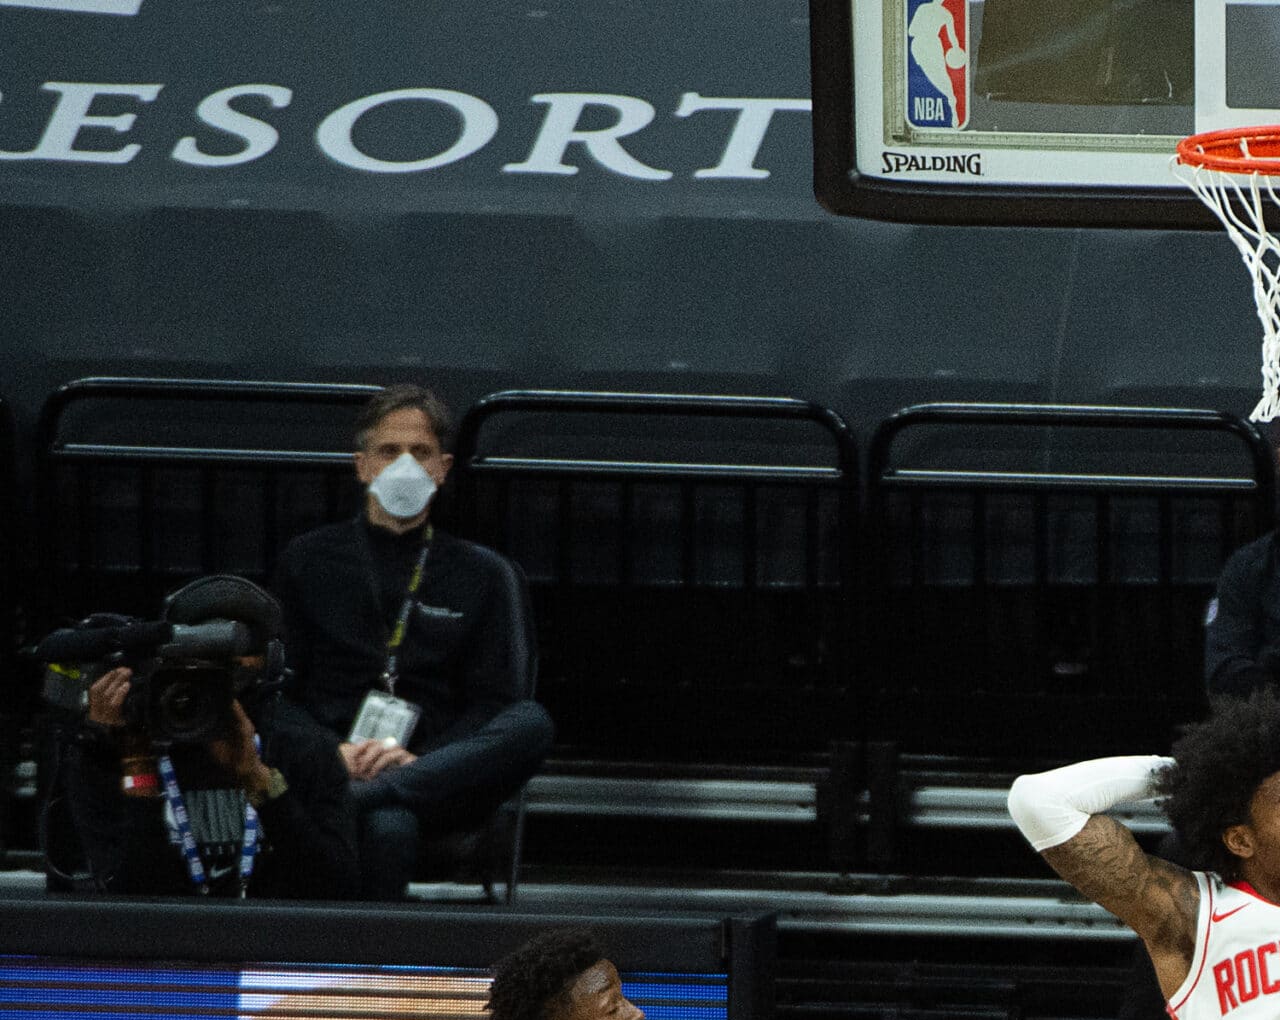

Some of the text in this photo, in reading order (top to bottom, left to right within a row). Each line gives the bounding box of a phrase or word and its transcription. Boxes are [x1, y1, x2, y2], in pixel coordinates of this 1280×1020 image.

[914, 97, 945, 121] NBA
[0, 81, 812, 180] ESORT
[882, 151, 982, 176] SPALDING
